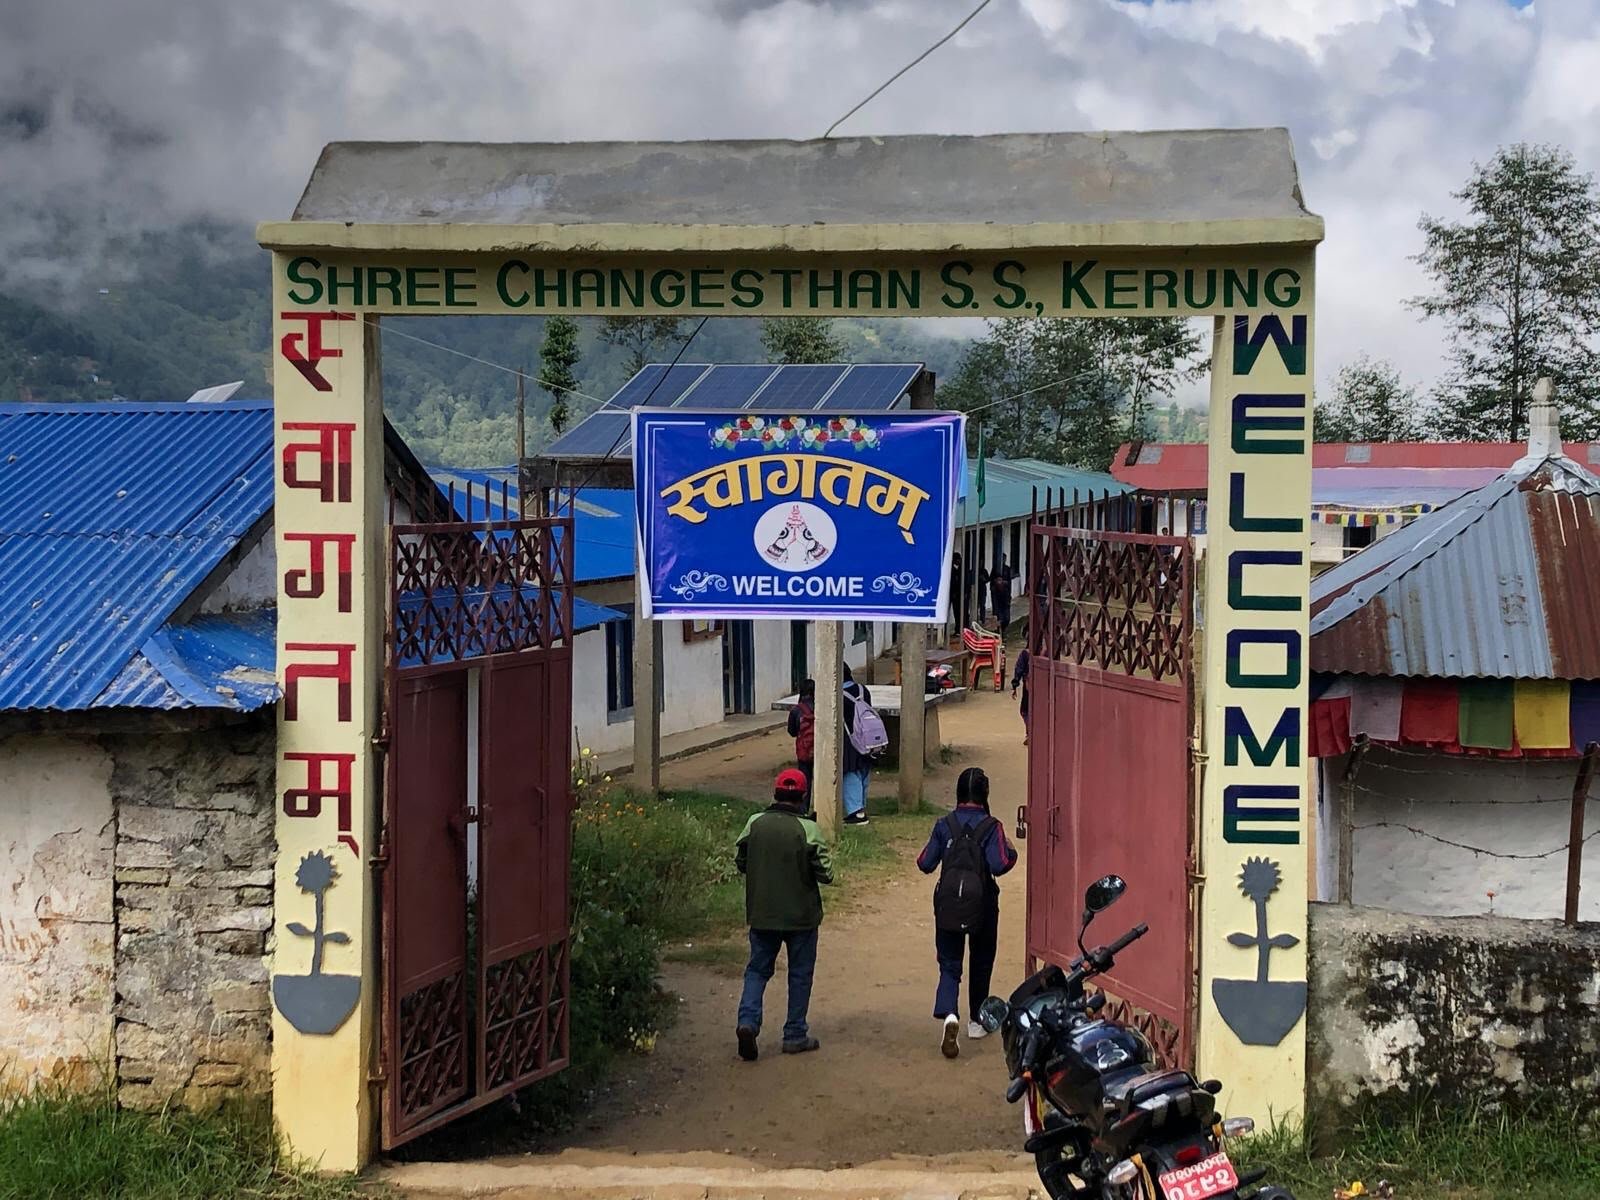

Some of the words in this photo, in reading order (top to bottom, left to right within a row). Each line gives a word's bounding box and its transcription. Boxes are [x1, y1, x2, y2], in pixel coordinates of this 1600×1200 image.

[286, 256, 478, 308] SHREE
[496, 259, 921, 309] CHANGESTHAN
[1062, 260, 1301, 309] KERUNG
[660, 453, 931, 545] स्वागतम्
[732, 575, 864, 598] WELCOME
[1222, 314, 1307, 845] WELCOME
